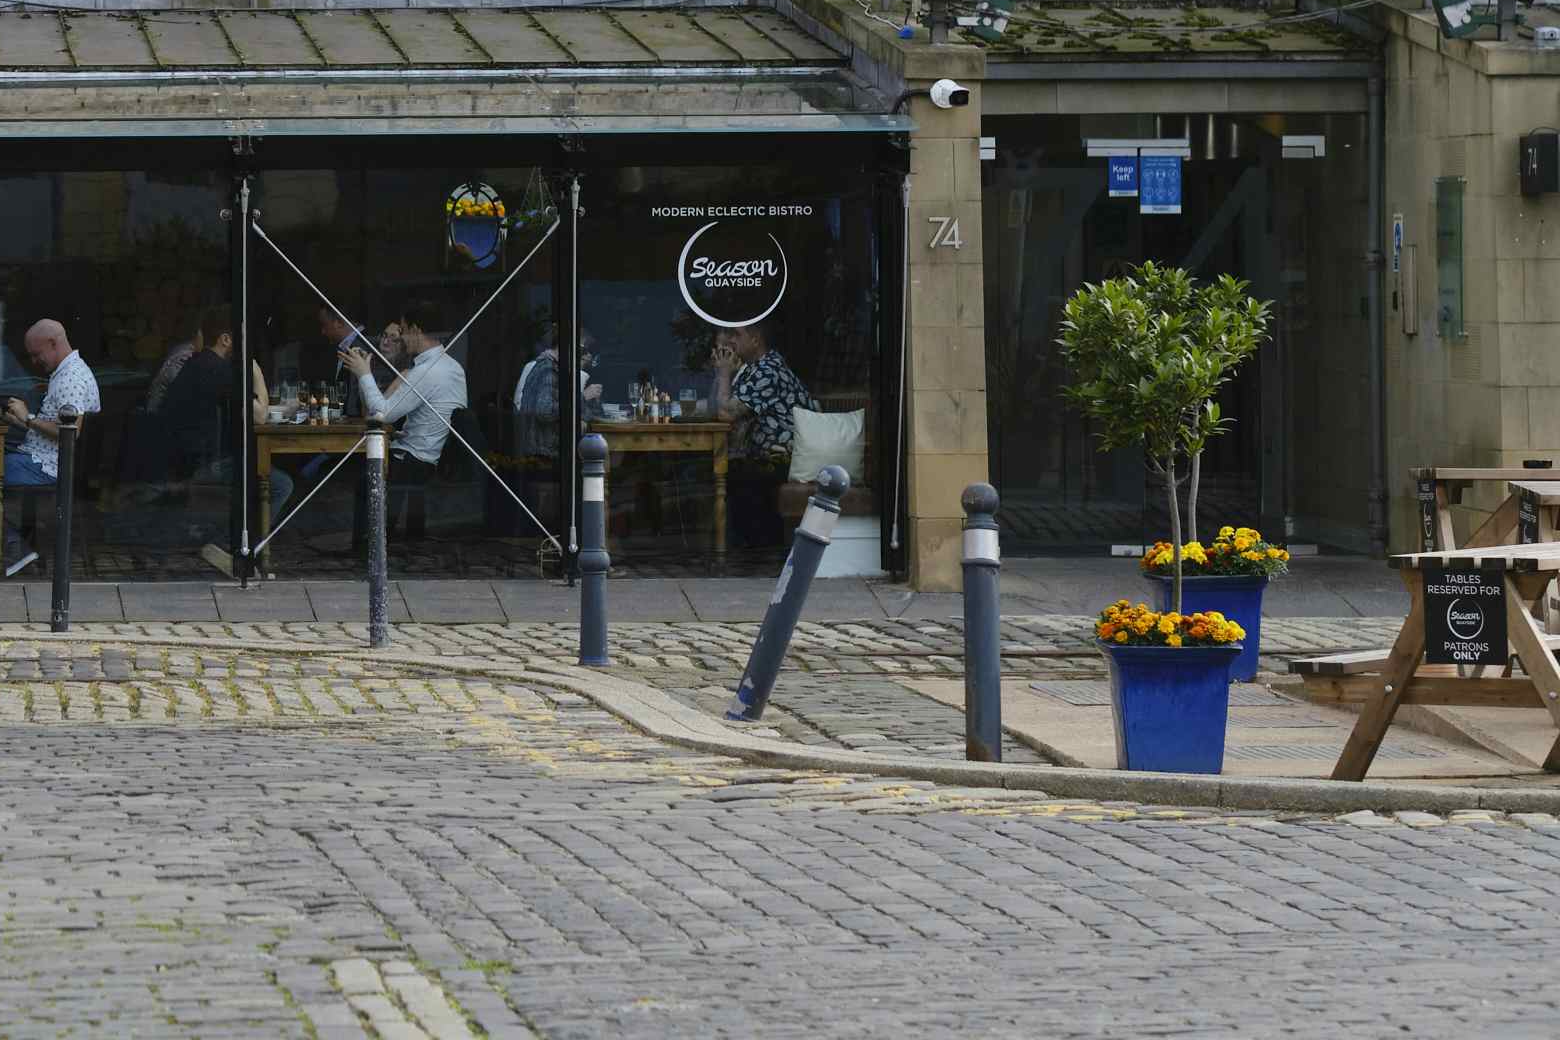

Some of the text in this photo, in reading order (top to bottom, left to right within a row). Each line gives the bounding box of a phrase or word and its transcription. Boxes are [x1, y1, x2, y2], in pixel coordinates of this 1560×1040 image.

[1112, 164, 1134, 174] Keep
[651, 206, 813, 217] MODERN ECLECTIC BISTRO
[929, 216, 963, 249] 74
[690, 257, 778, 278] Season
[704, 277, 762, 288] QUAYSIDE
[1444, 574, 1481, 584] TABLES
[1427, 585, 1501, 596] RESERVED FOR
[1444, 641, 1490, 652] PATRONS
[1453, 651, 1480, 661] ONLY
